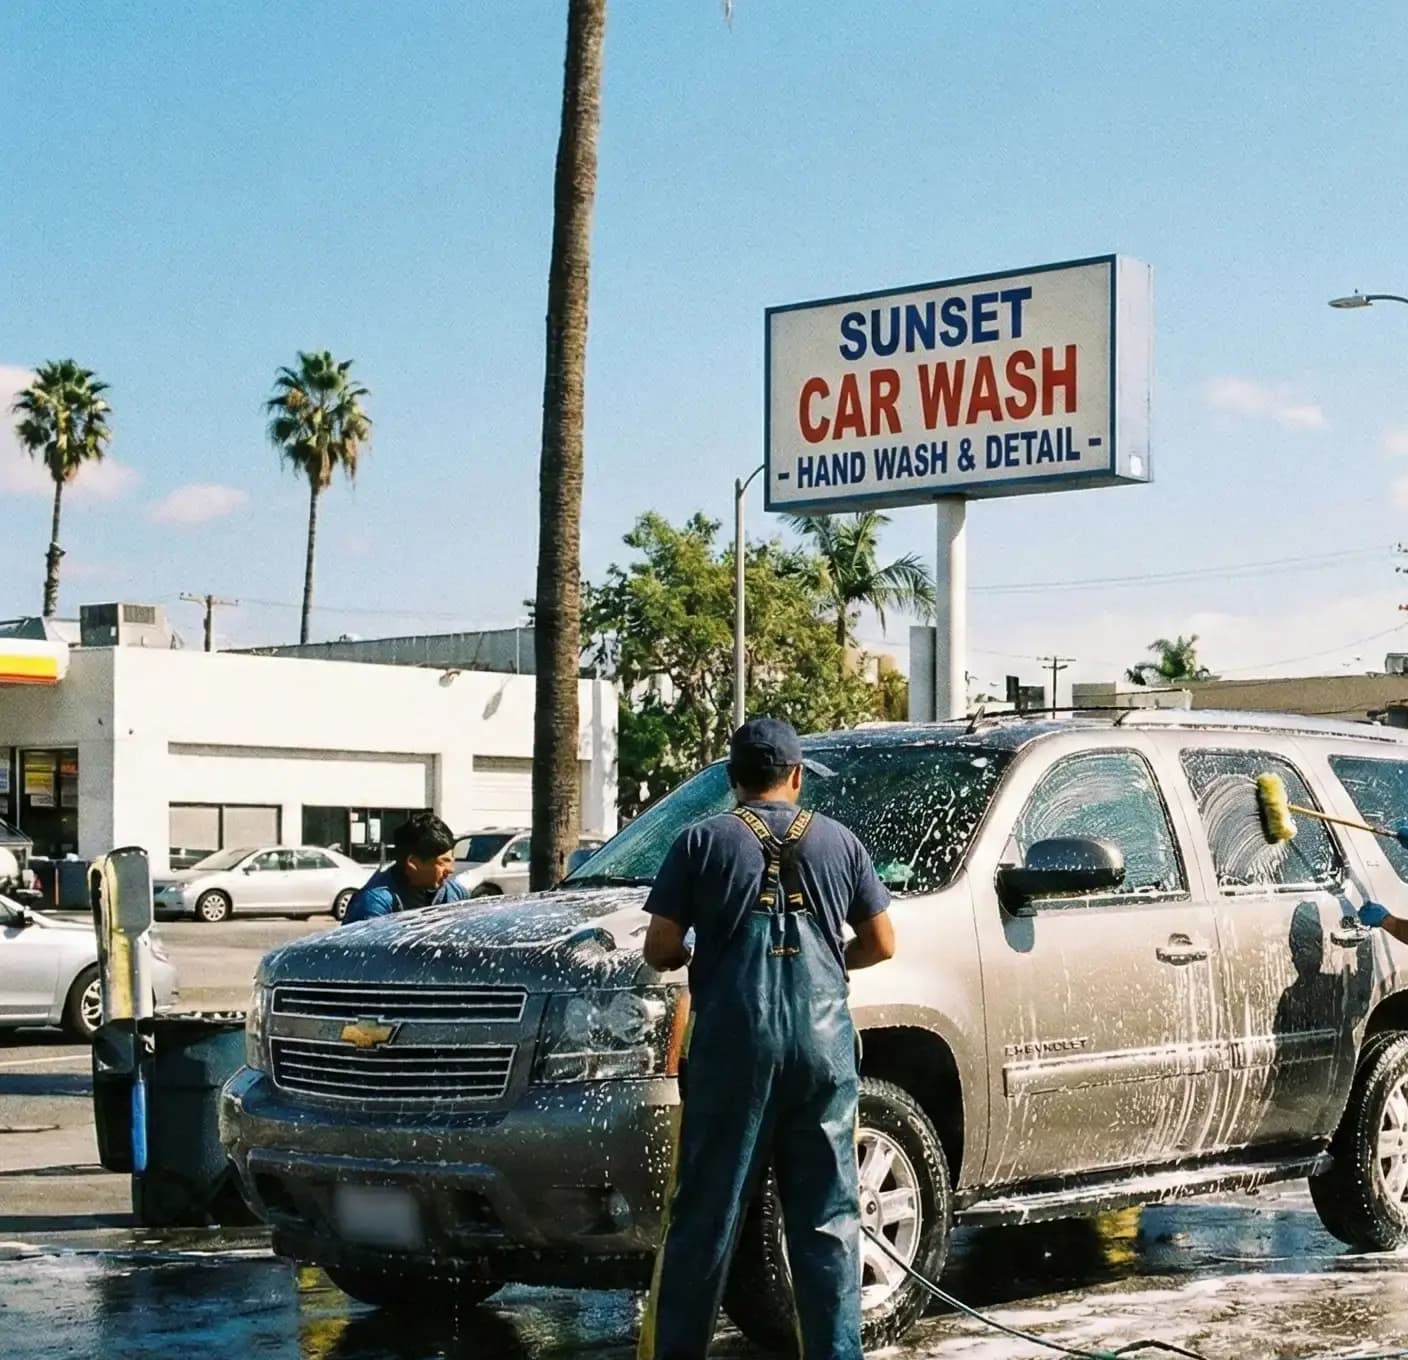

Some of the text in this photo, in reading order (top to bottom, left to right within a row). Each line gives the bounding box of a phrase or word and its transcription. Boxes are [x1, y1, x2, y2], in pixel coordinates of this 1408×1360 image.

[839, 286, 1032, 361] SUNSET
[799, 344, 1077, 444] CAR WASH
[797, 452, 866, 489] HAND
[875, 440, 948, 481] WASH
[957, 437, 976, 472] &
[985, 427, 1081, 469] DETAIL
[1004, 1039, 1087, 1057] CHEVROLET
